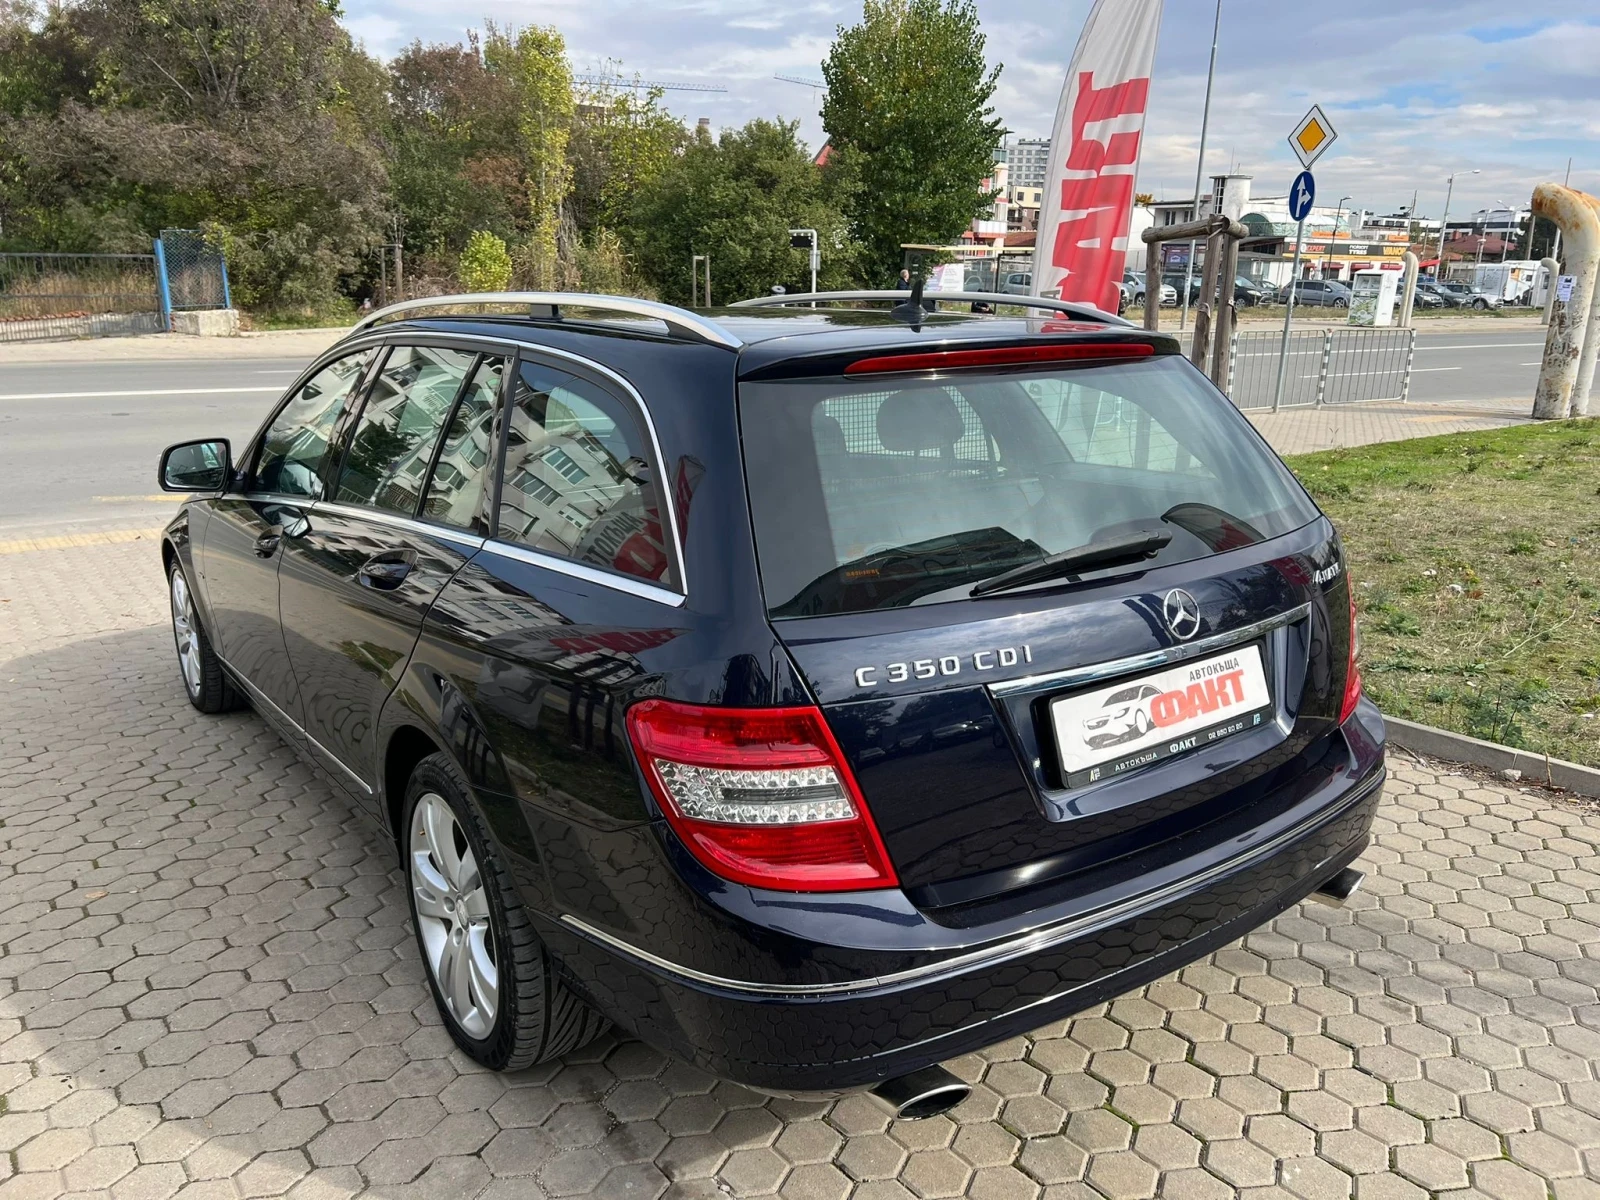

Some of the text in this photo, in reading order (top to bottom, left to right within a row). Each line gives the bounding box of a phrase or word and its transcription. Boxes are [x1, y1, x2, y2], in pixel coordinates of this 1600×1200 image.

[855, 644, 1032, 688] C 350 CDI
[1189, 657, 1240, 682] АВТОКЪЩА
[1150, 669, 1245, 728] ФАКТ
[1169, 736, 1197, 754] ФАКТ
